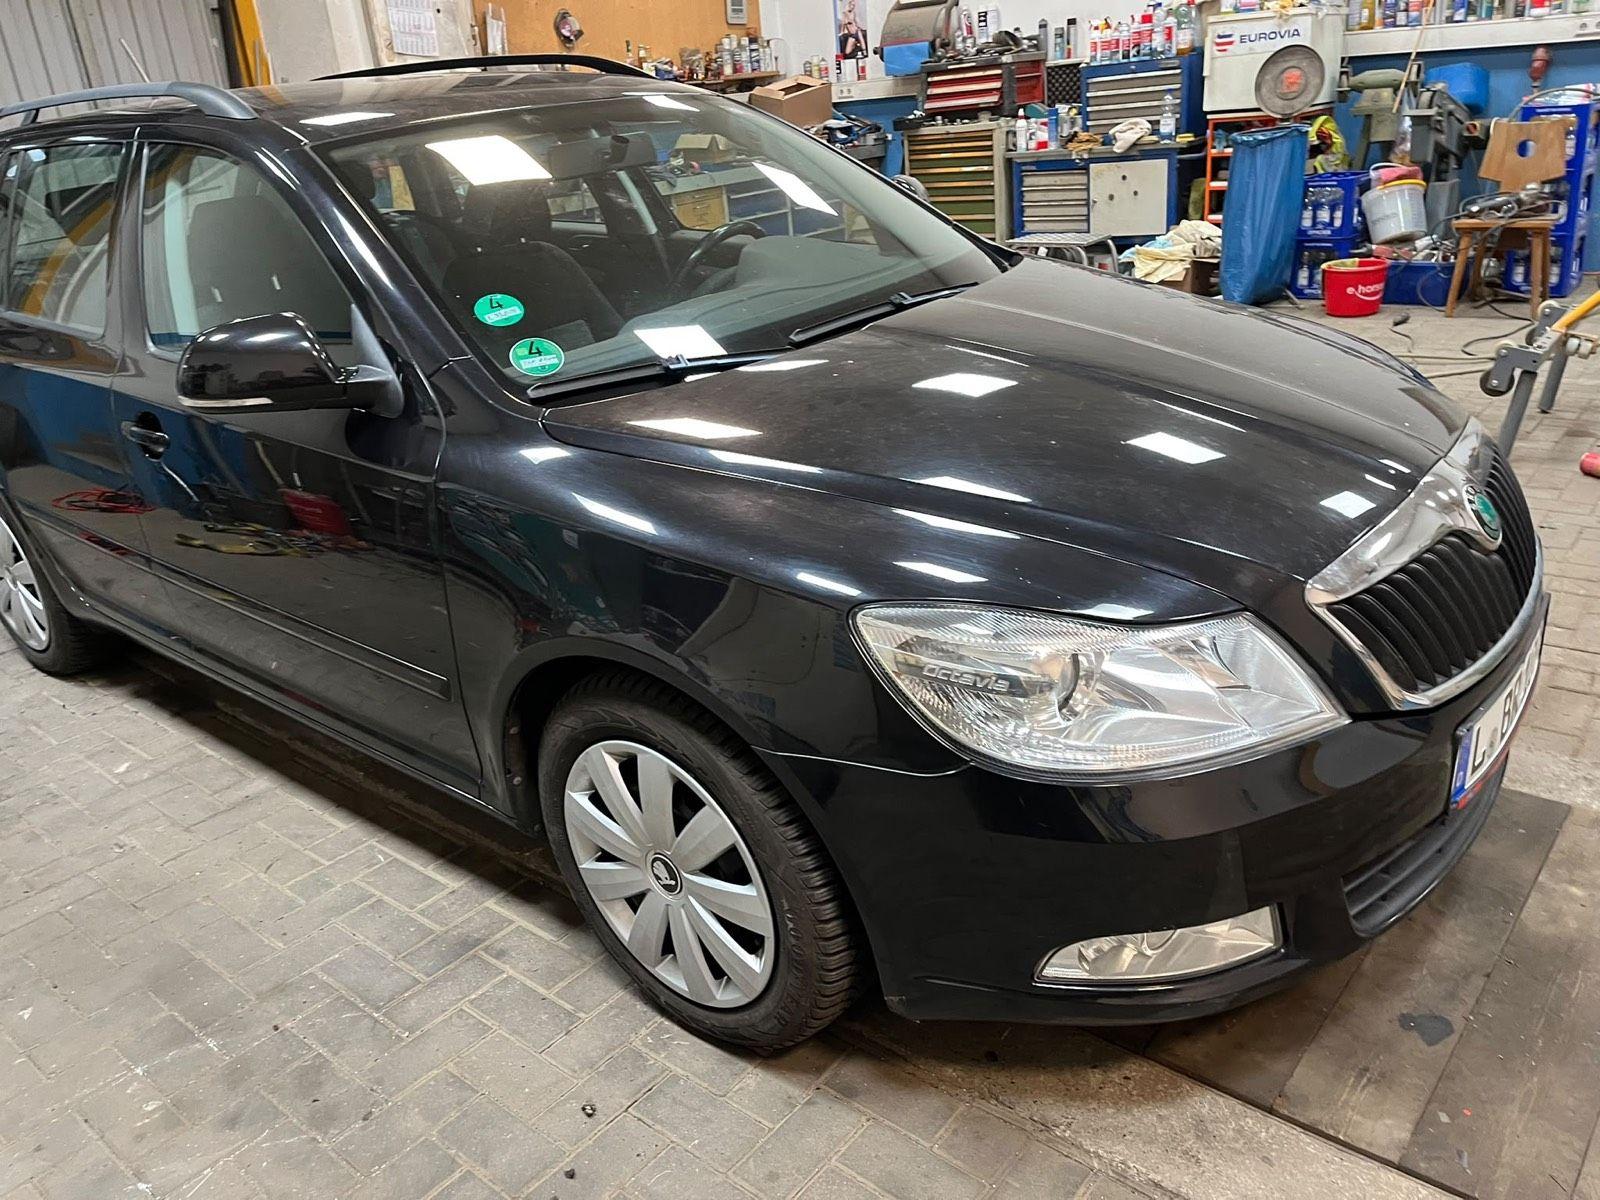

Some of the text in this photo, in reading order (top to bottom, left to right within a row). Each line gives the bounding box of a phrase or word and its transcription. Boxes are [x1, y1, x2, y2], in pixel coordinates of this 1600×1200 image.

[1239, 28, 1301, 44] EUROVIA
[489, 296, 503, 309] 4
[528, 341, 543, 356] 4
